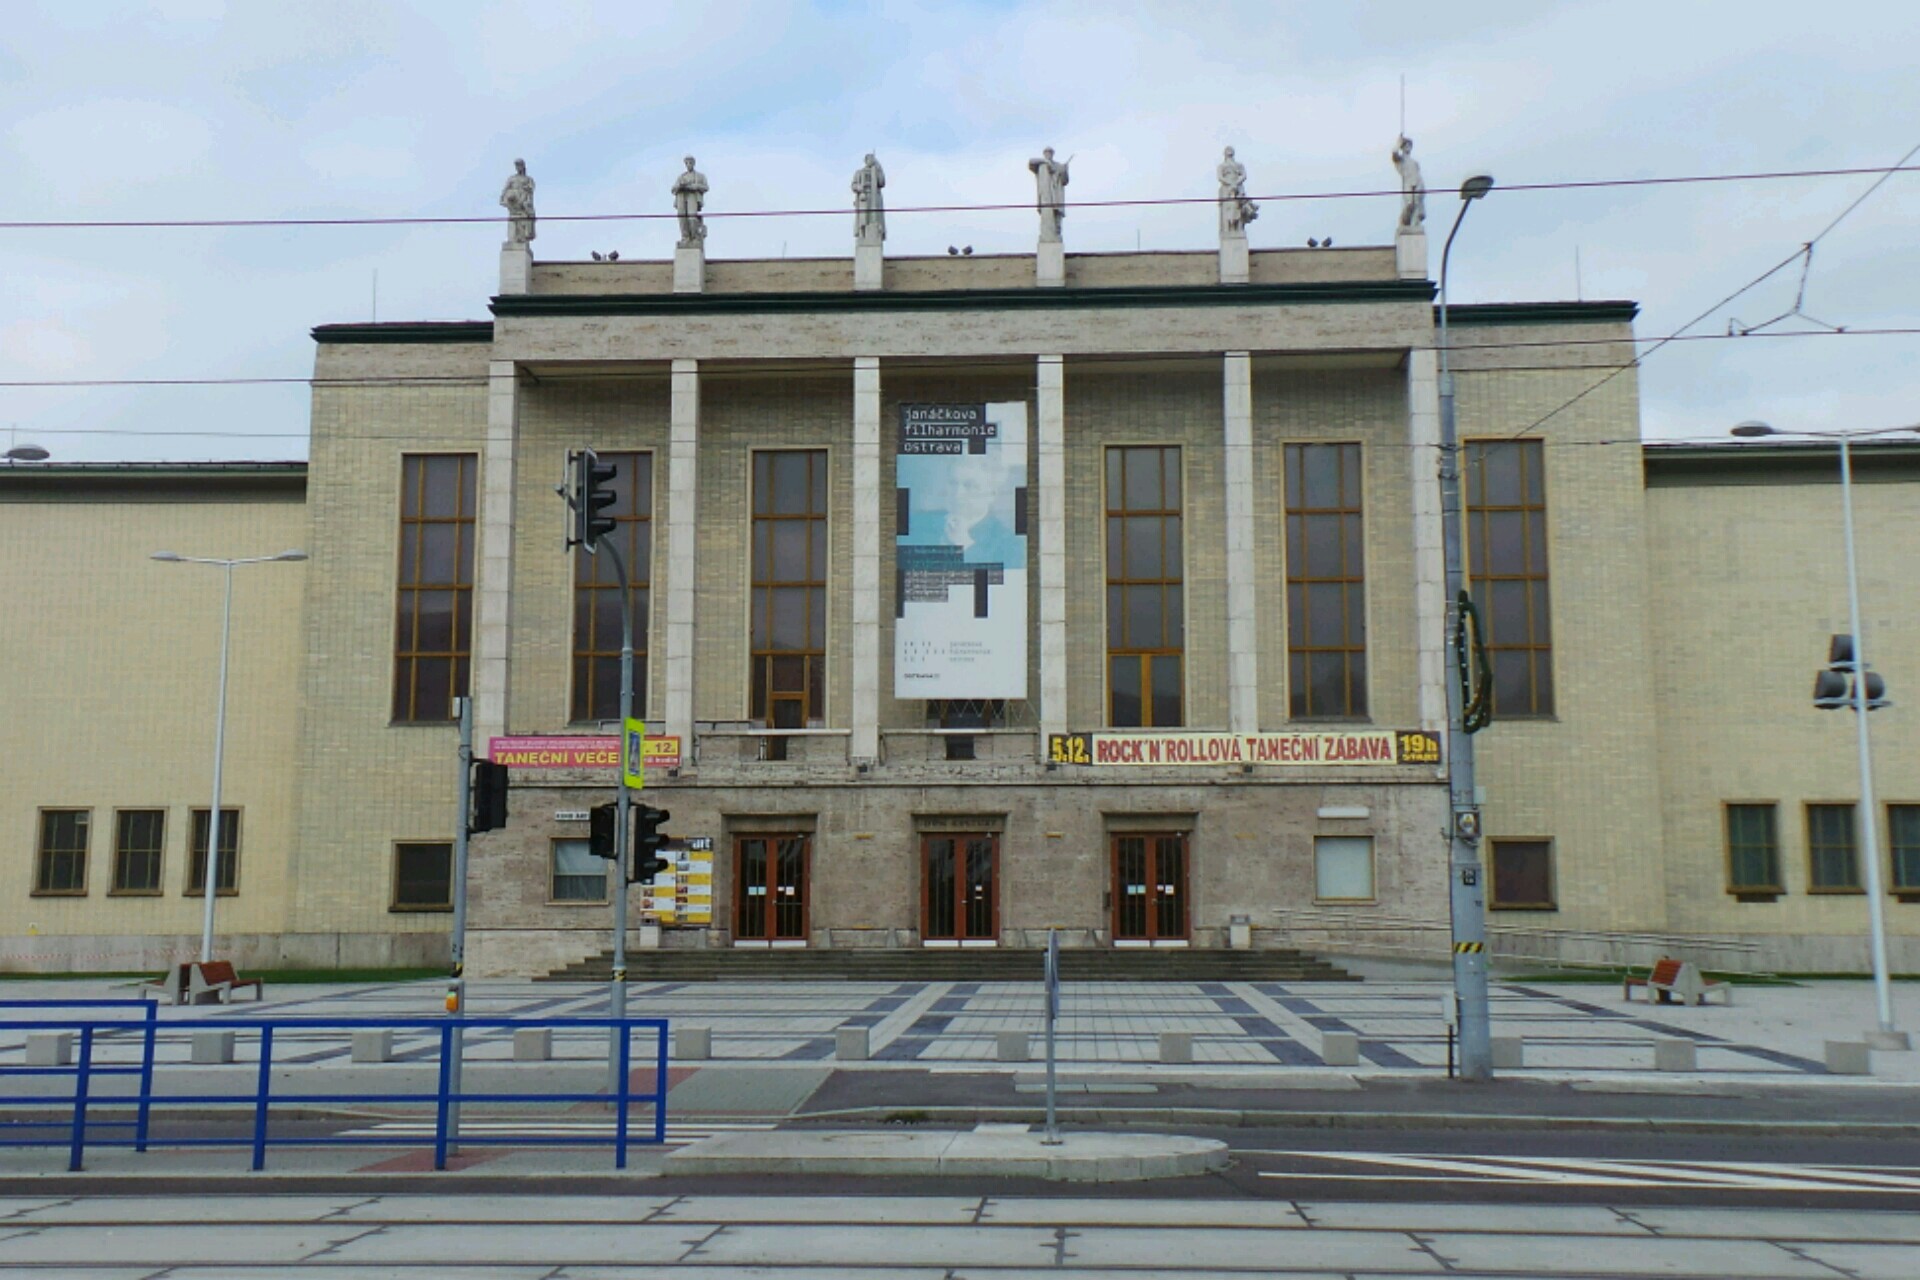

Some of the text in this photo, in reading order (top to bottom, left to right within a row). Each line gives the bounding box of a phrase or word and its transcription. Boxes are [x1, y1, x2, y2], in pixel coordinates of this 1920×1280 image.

[905, 424, 996, 436] filharmonie
[904, 441, 961, 453] ostrava
[1052, 735, 1090, 764] 5.12.
[1246, 733, 1320, 761] TANEČNÍ
[1324, 733, 1392, 761] ZÁBAVA
[1400, 734, 1438, 753] 19h
[494, 750, 619, 764] TANEČNÍ VEČE
